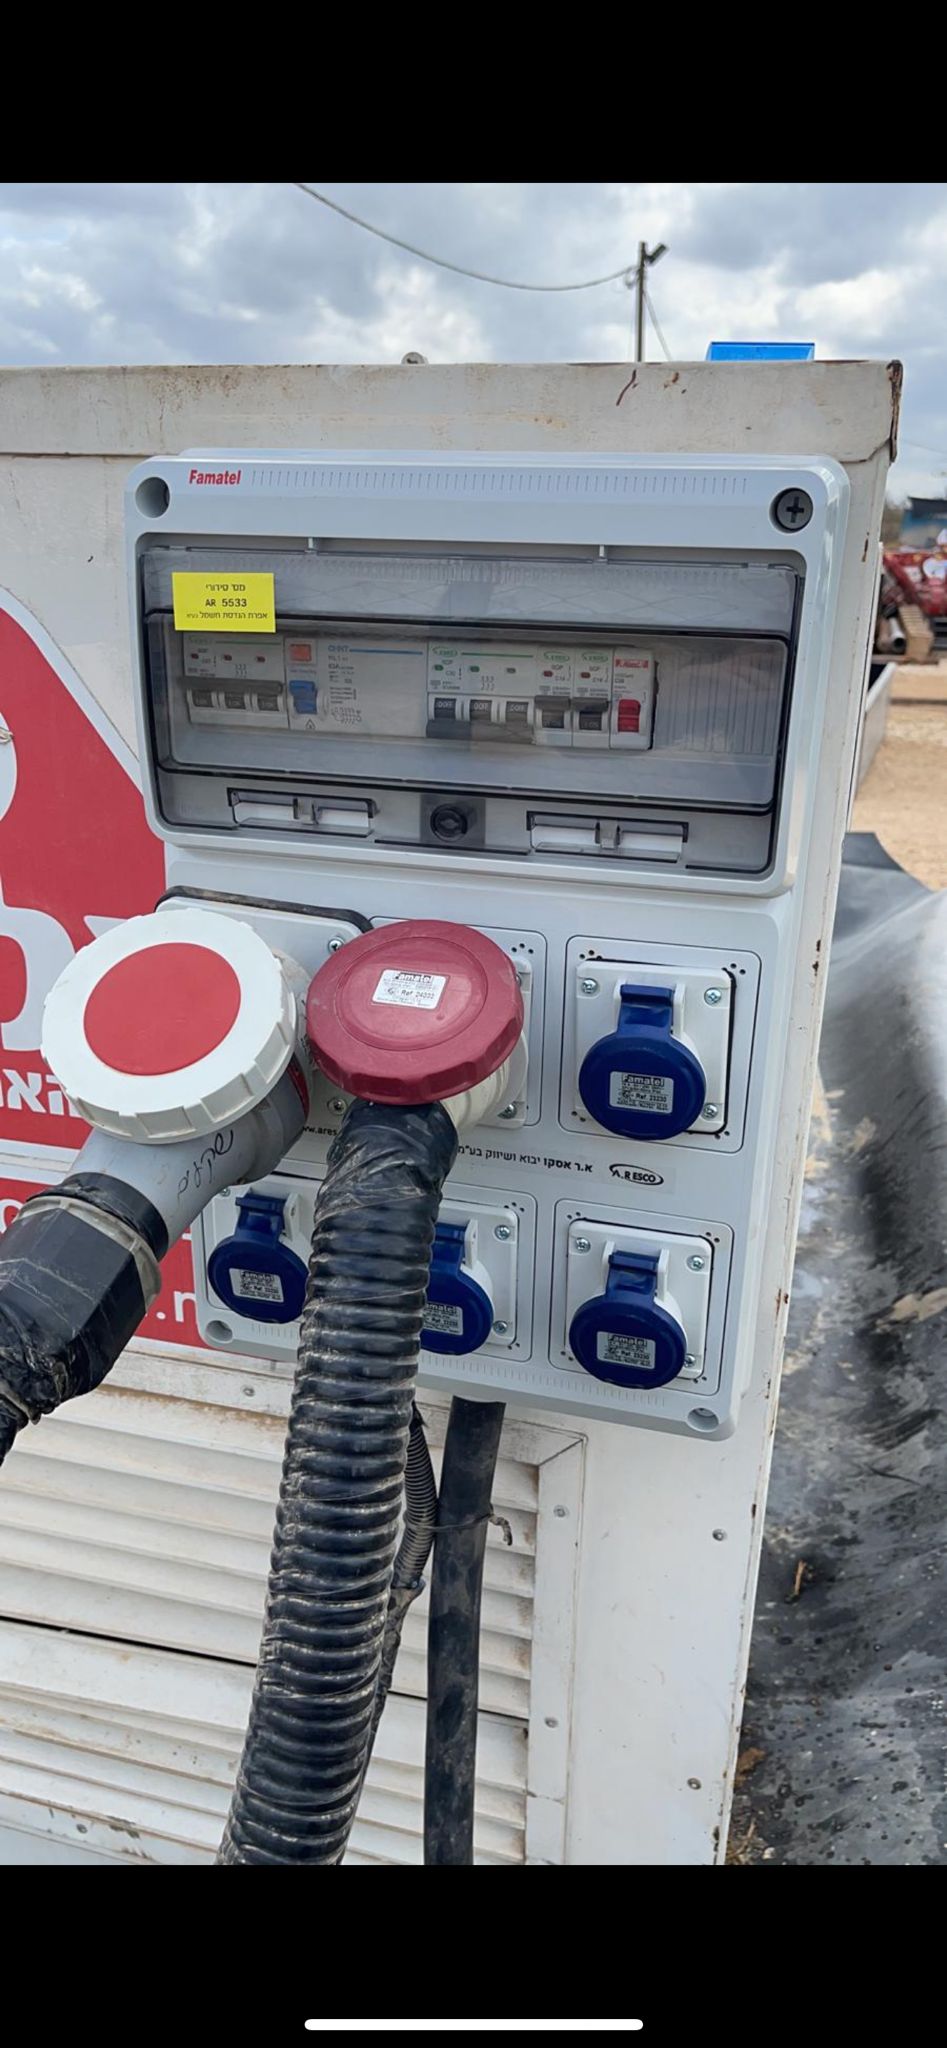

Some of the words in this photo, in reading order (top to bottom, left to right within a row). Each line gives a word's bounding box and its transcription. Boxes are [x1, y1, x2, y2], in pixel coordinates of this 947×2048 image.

[189, 469, 241, 485] Famatel
[205, 598, 217, 607] AR
[221, 598, 247, 608] 5533
[621, 1073, 665, 1087] Famatel
[485, 1149, 517, 1162] ושיווק
[519, 1154, 542, 1166] יבוא
[544, 1157, 572, 1171] אסקו
